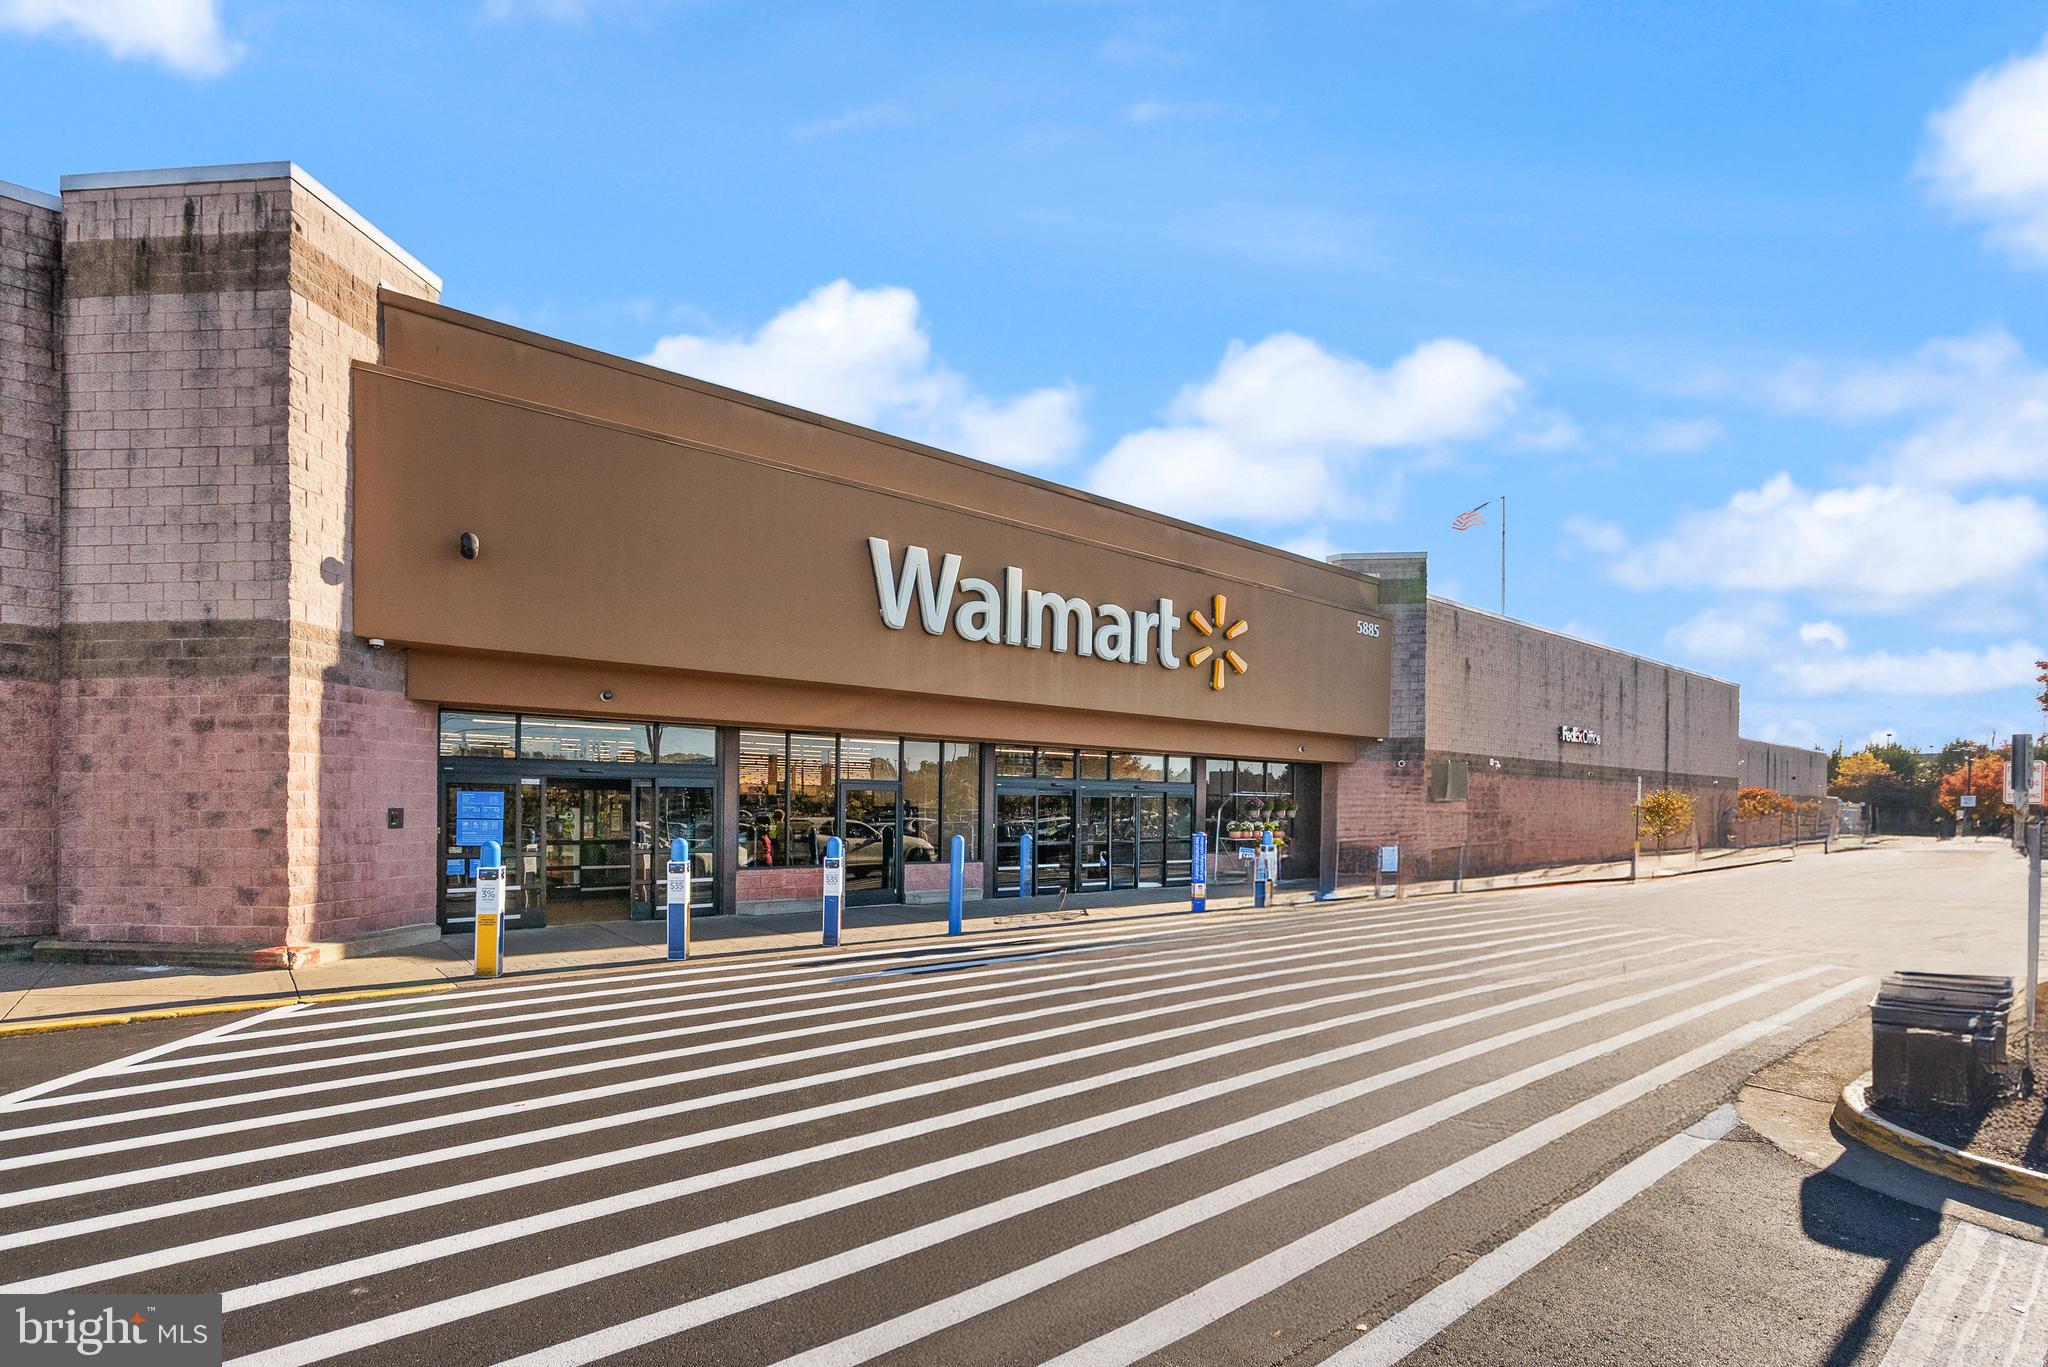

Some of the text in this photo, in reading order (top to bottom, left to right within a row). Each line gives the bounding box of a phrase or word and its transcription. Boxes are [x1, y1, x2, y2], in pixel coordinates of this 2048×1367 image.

[868, 537, 1180, 669] Walmart
[1356, 620, 1380, 638] 5885
[1562, 725, 1583, 743] FedEx
[481, 889, 496, 899] 3%
[670, 881, 684, 890] $35
